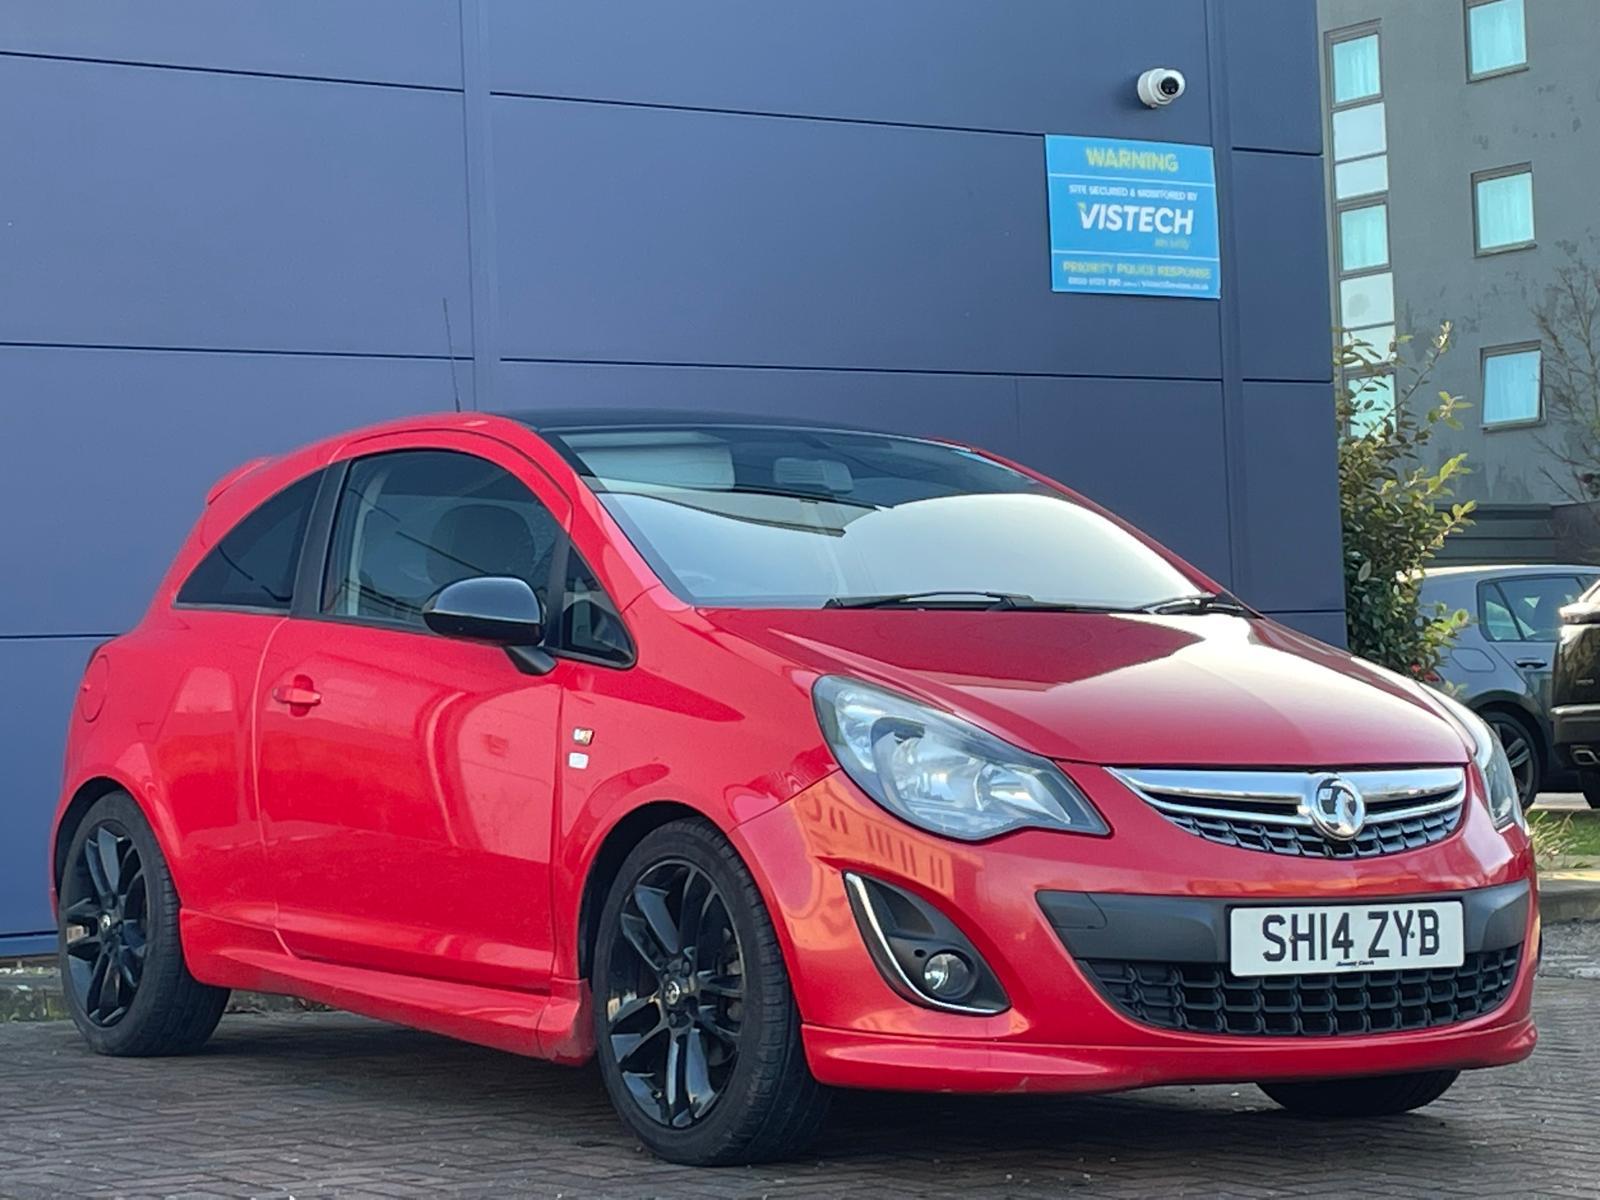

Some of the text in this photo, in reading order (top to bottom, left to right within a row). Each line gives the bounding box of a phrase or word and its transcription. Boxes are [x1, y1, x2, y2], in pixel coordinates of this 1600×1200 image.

[1085, 147, 1179, 172] WARNING
[1078, 202, 1195, 235] VISTECH
[1262, 909, 1440, 962] SH14 ZYB
